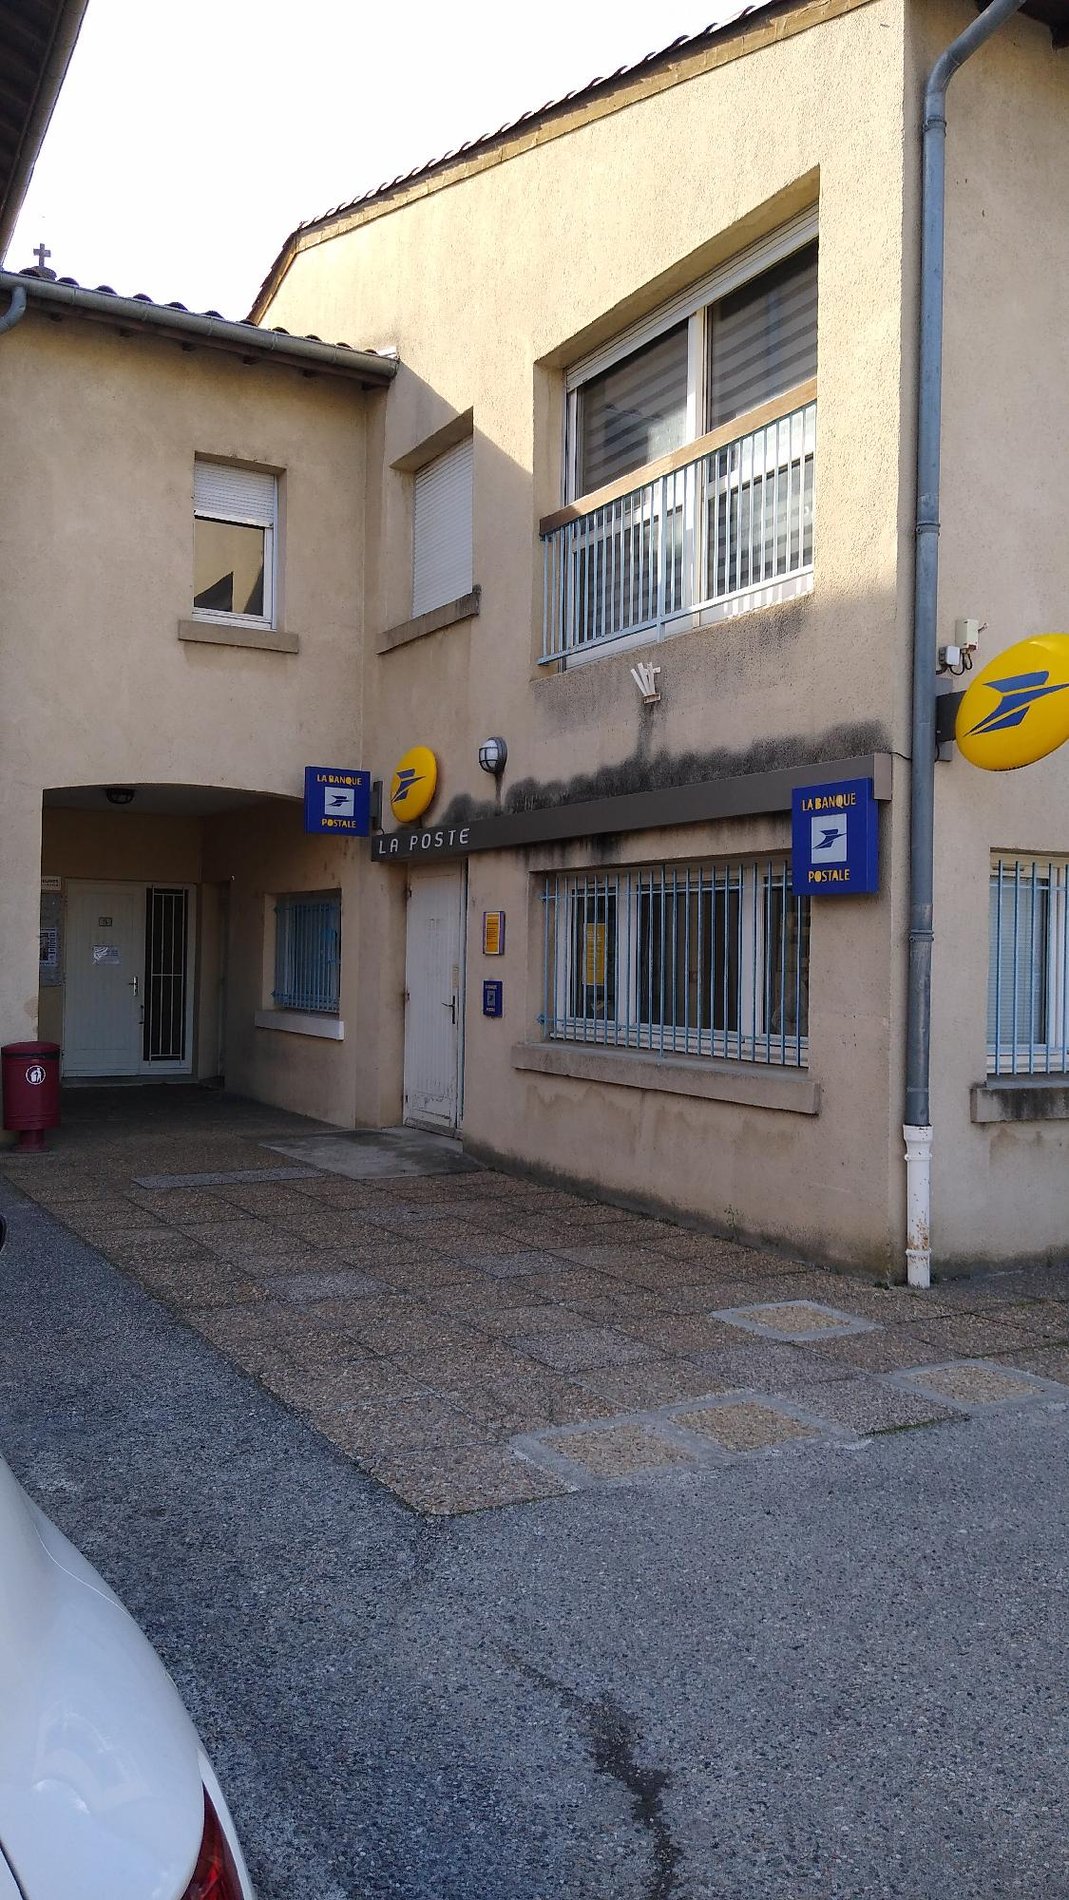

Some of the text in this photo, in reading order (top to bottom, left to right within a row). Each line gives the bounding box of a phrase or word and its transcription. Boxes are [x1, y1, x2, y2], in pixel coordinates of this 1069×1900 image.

[316, 774, 362, 786] LA BANQUE
[802, 793, 856, 811] LA BANQUE
[321, 818, 357, 828] POSTALE
[379, 828, 470, 854] LA POSTE
[808, 868, 850, 883] POSTALE
